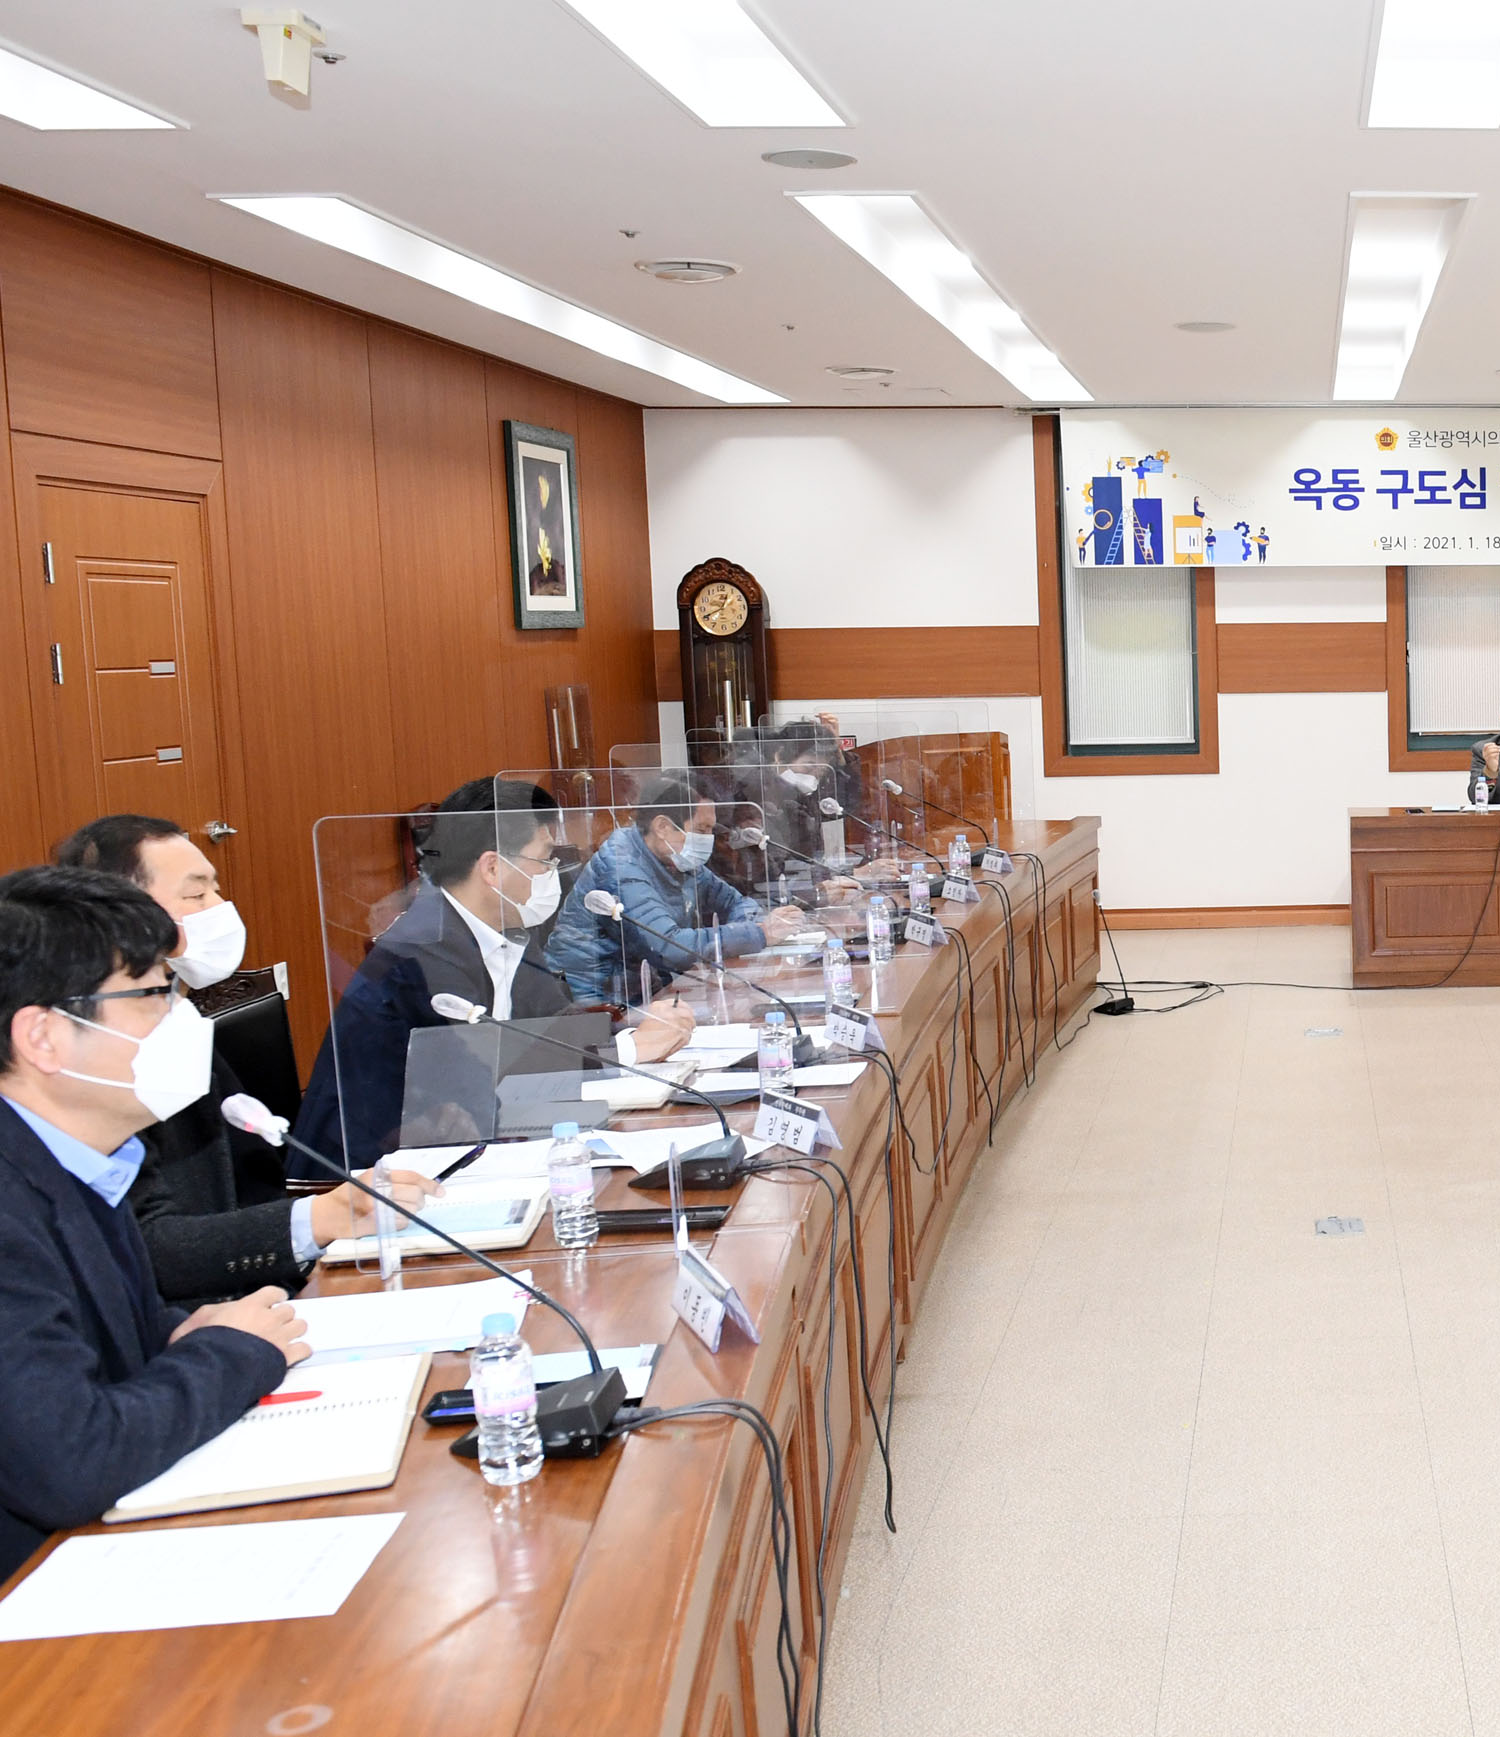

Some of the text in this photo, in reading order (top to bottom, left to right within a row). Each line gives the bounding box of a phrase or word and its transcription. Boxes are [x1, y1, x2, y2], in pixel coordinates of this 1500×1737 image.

[1288, 467, 1365, 511] 옥동
[1376, 466, 1487, 510] 구도심
[1379, 536, 1407, 551] 일시
[1423, 536, 1463, 551] 2021.
